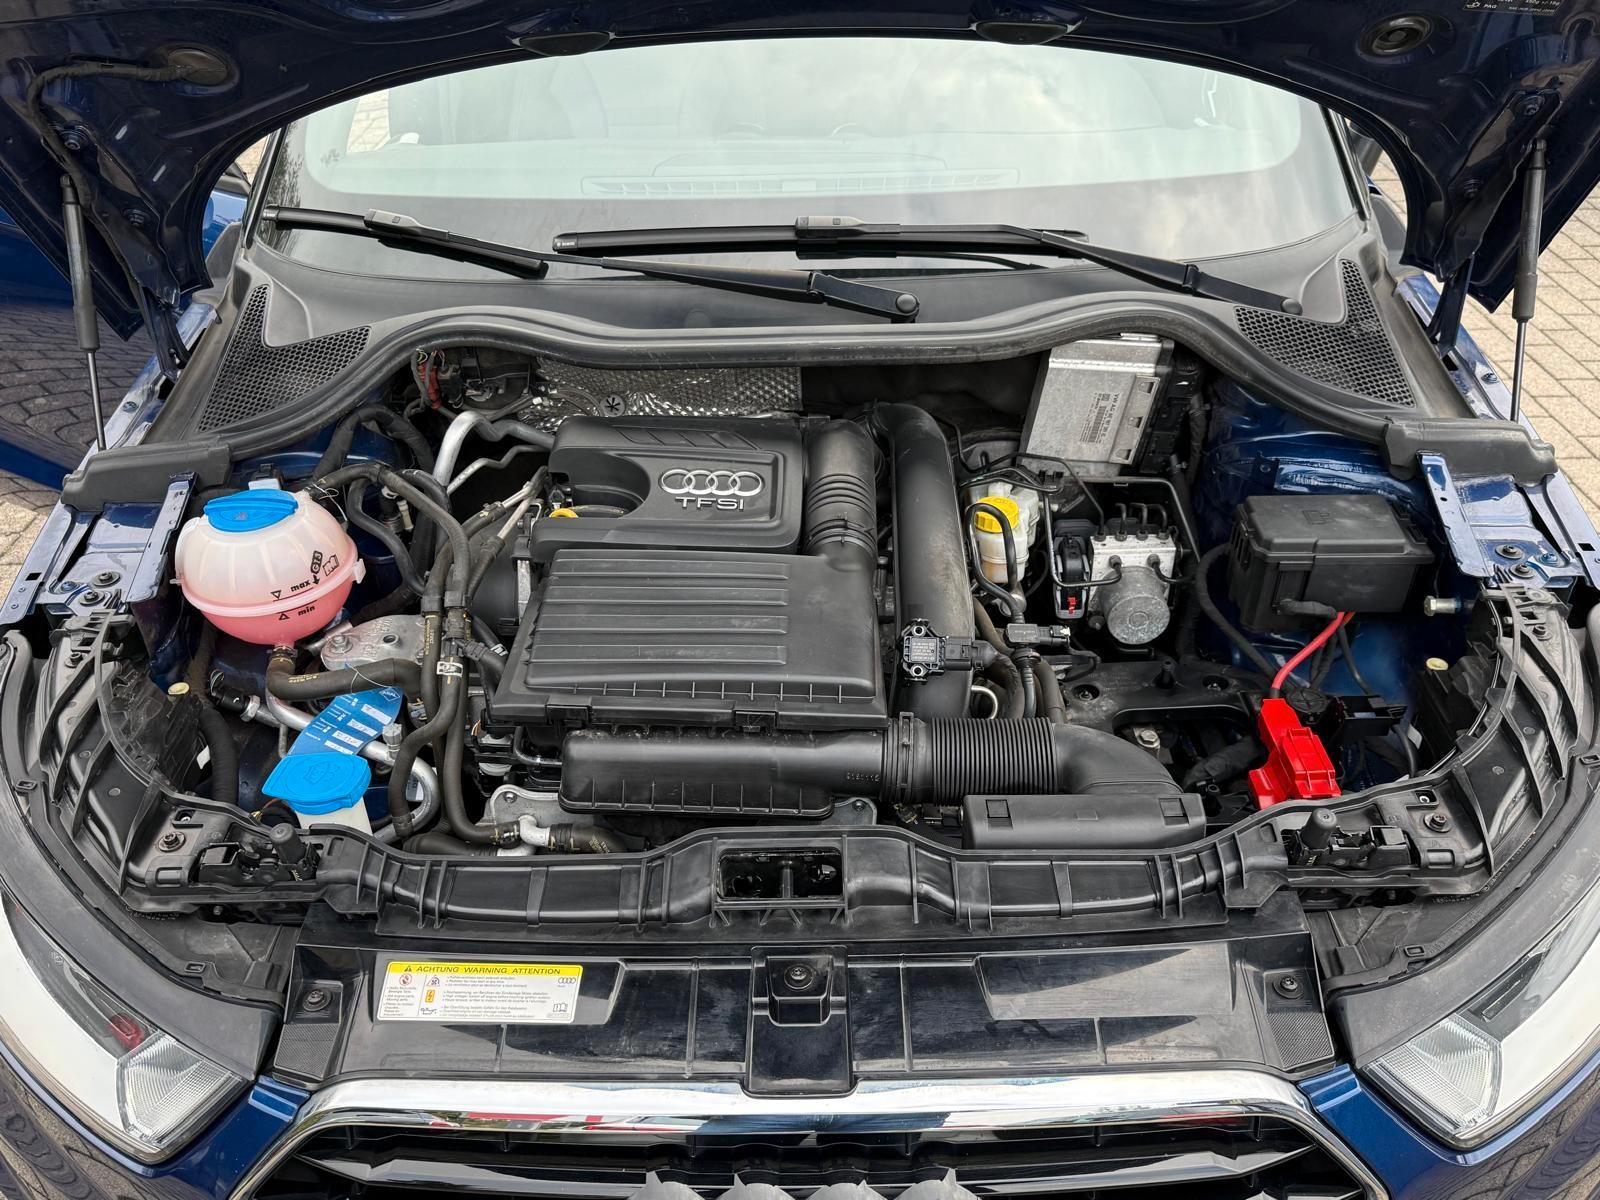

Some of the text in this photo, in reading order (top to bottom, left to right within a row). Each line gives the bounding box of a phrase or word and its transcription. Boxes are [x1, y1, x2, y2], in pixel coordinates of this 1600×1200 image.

[675, 496, 744, 511] TFSI
[290, 579, 311, 592] max
[298, 605, 316, 616] min
